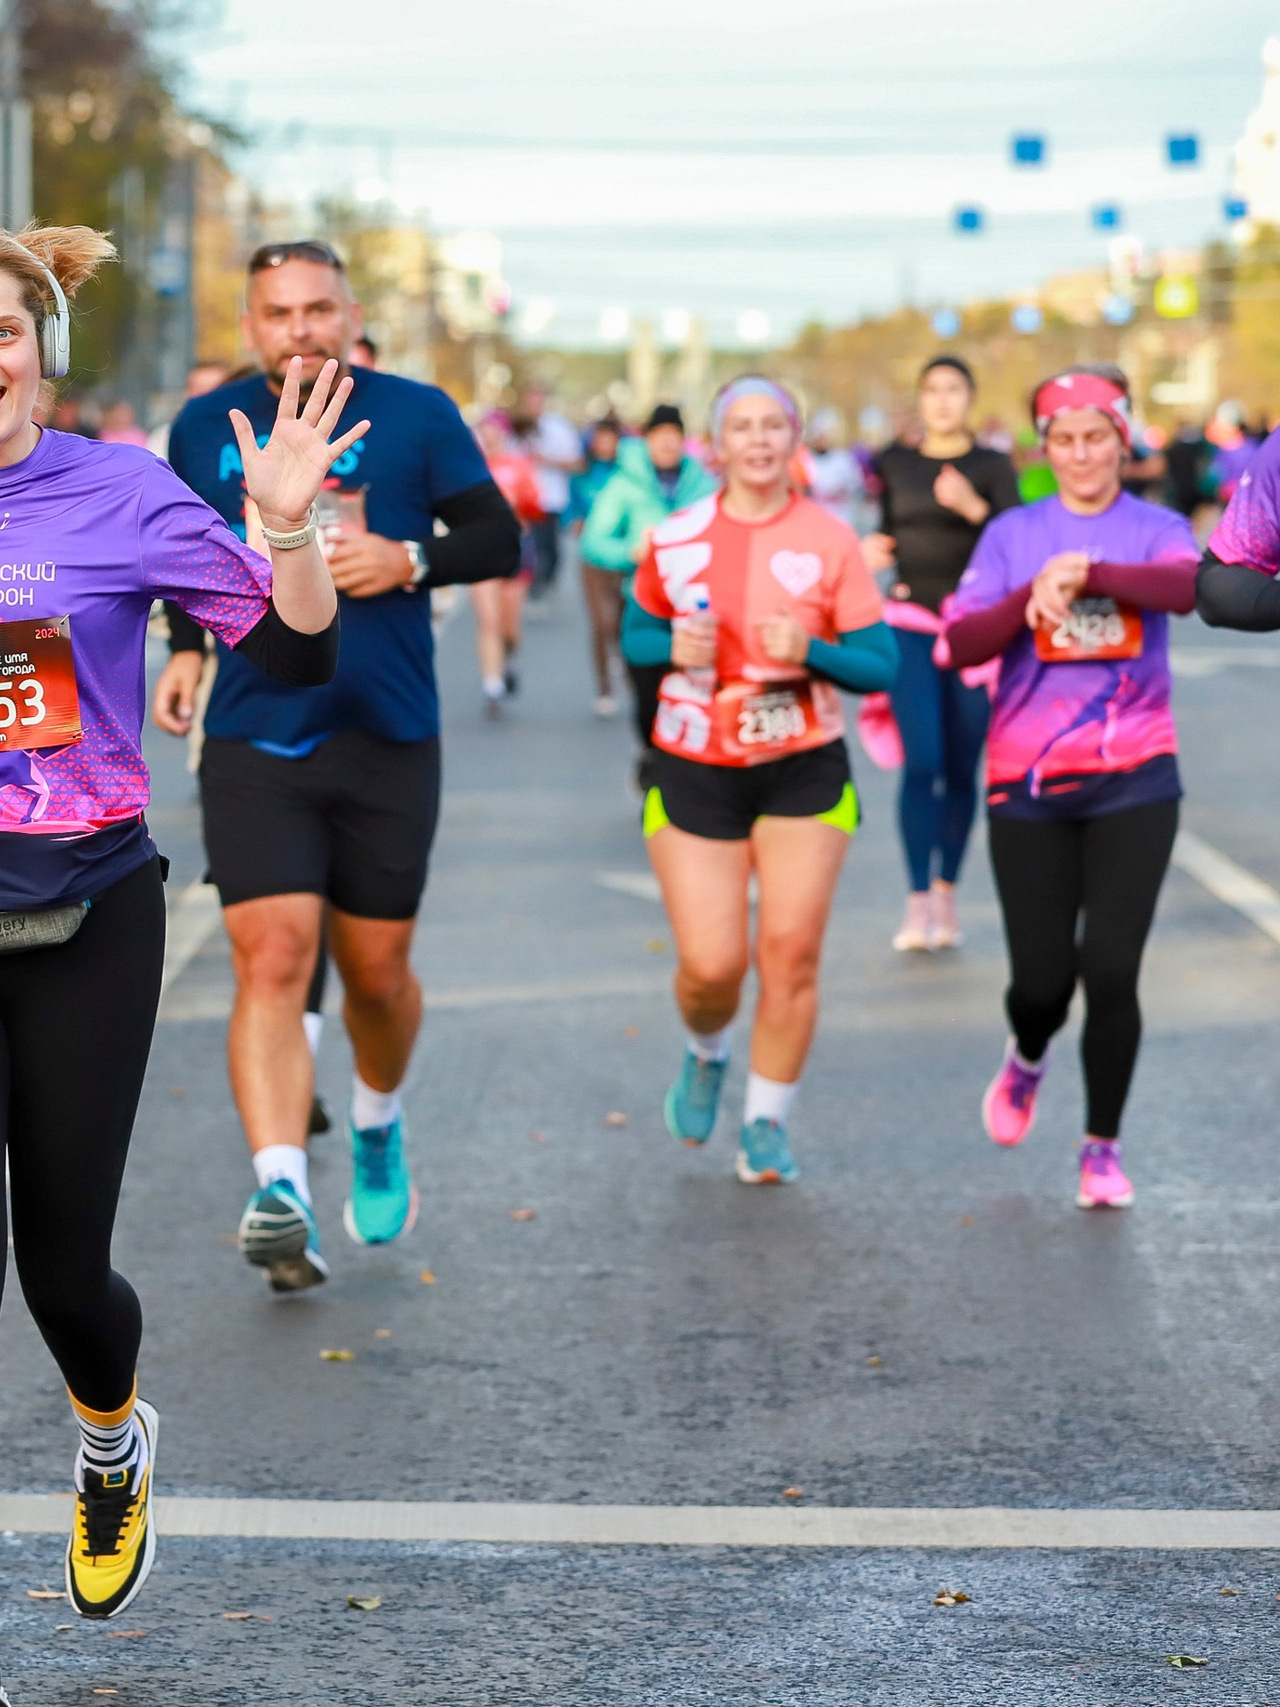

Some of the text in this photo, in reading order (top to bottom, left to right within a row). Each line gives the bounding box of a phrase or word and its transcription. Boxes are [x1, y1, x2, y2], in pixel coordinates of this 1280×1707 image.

[35, 627, 60, 639] 2024
[1050, 613, 1126, 648] 2428
[4, 652, 28, 664] ИМЯ
